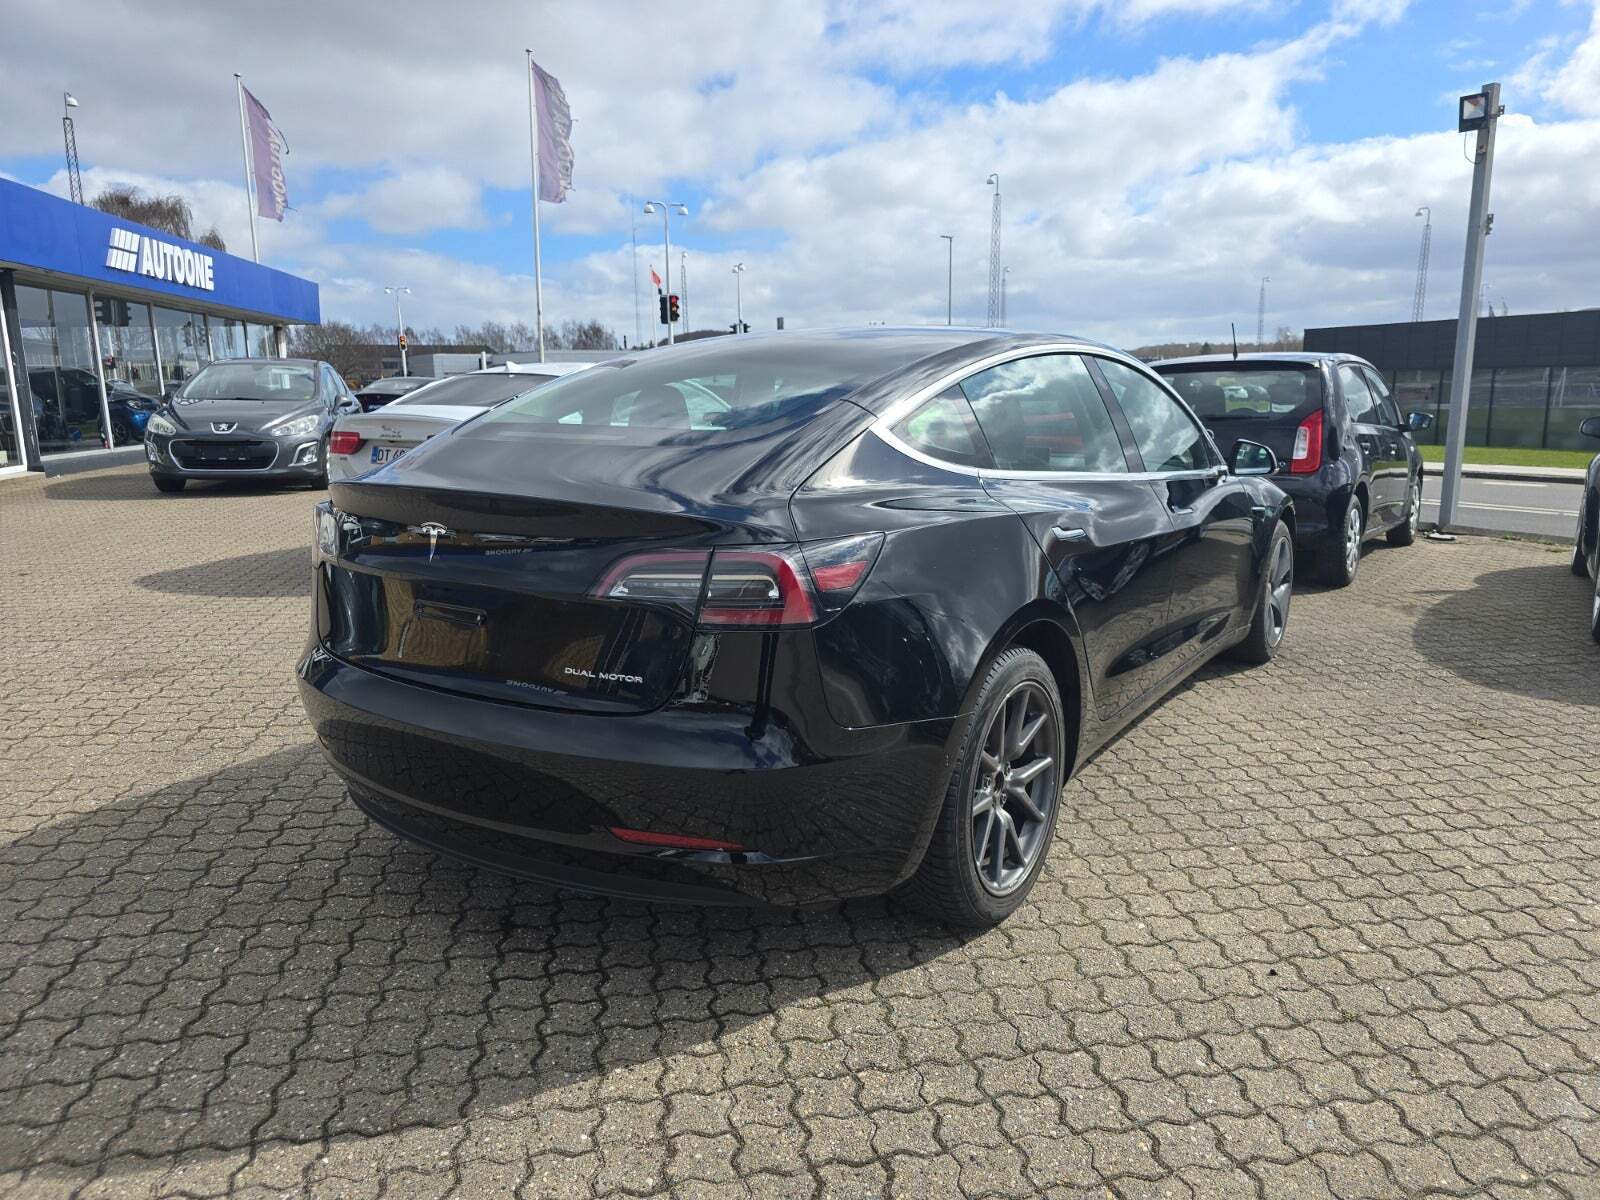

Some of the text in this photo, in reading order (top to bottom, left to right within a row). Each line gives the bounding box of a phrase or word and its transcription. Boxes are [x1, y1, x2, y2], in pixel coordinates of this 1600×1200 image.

[138, 236, 215, 291] AUTOONE
[377, 448, 392, 462] DT
[564, 667, 643, 683] DUAL MOTOR
